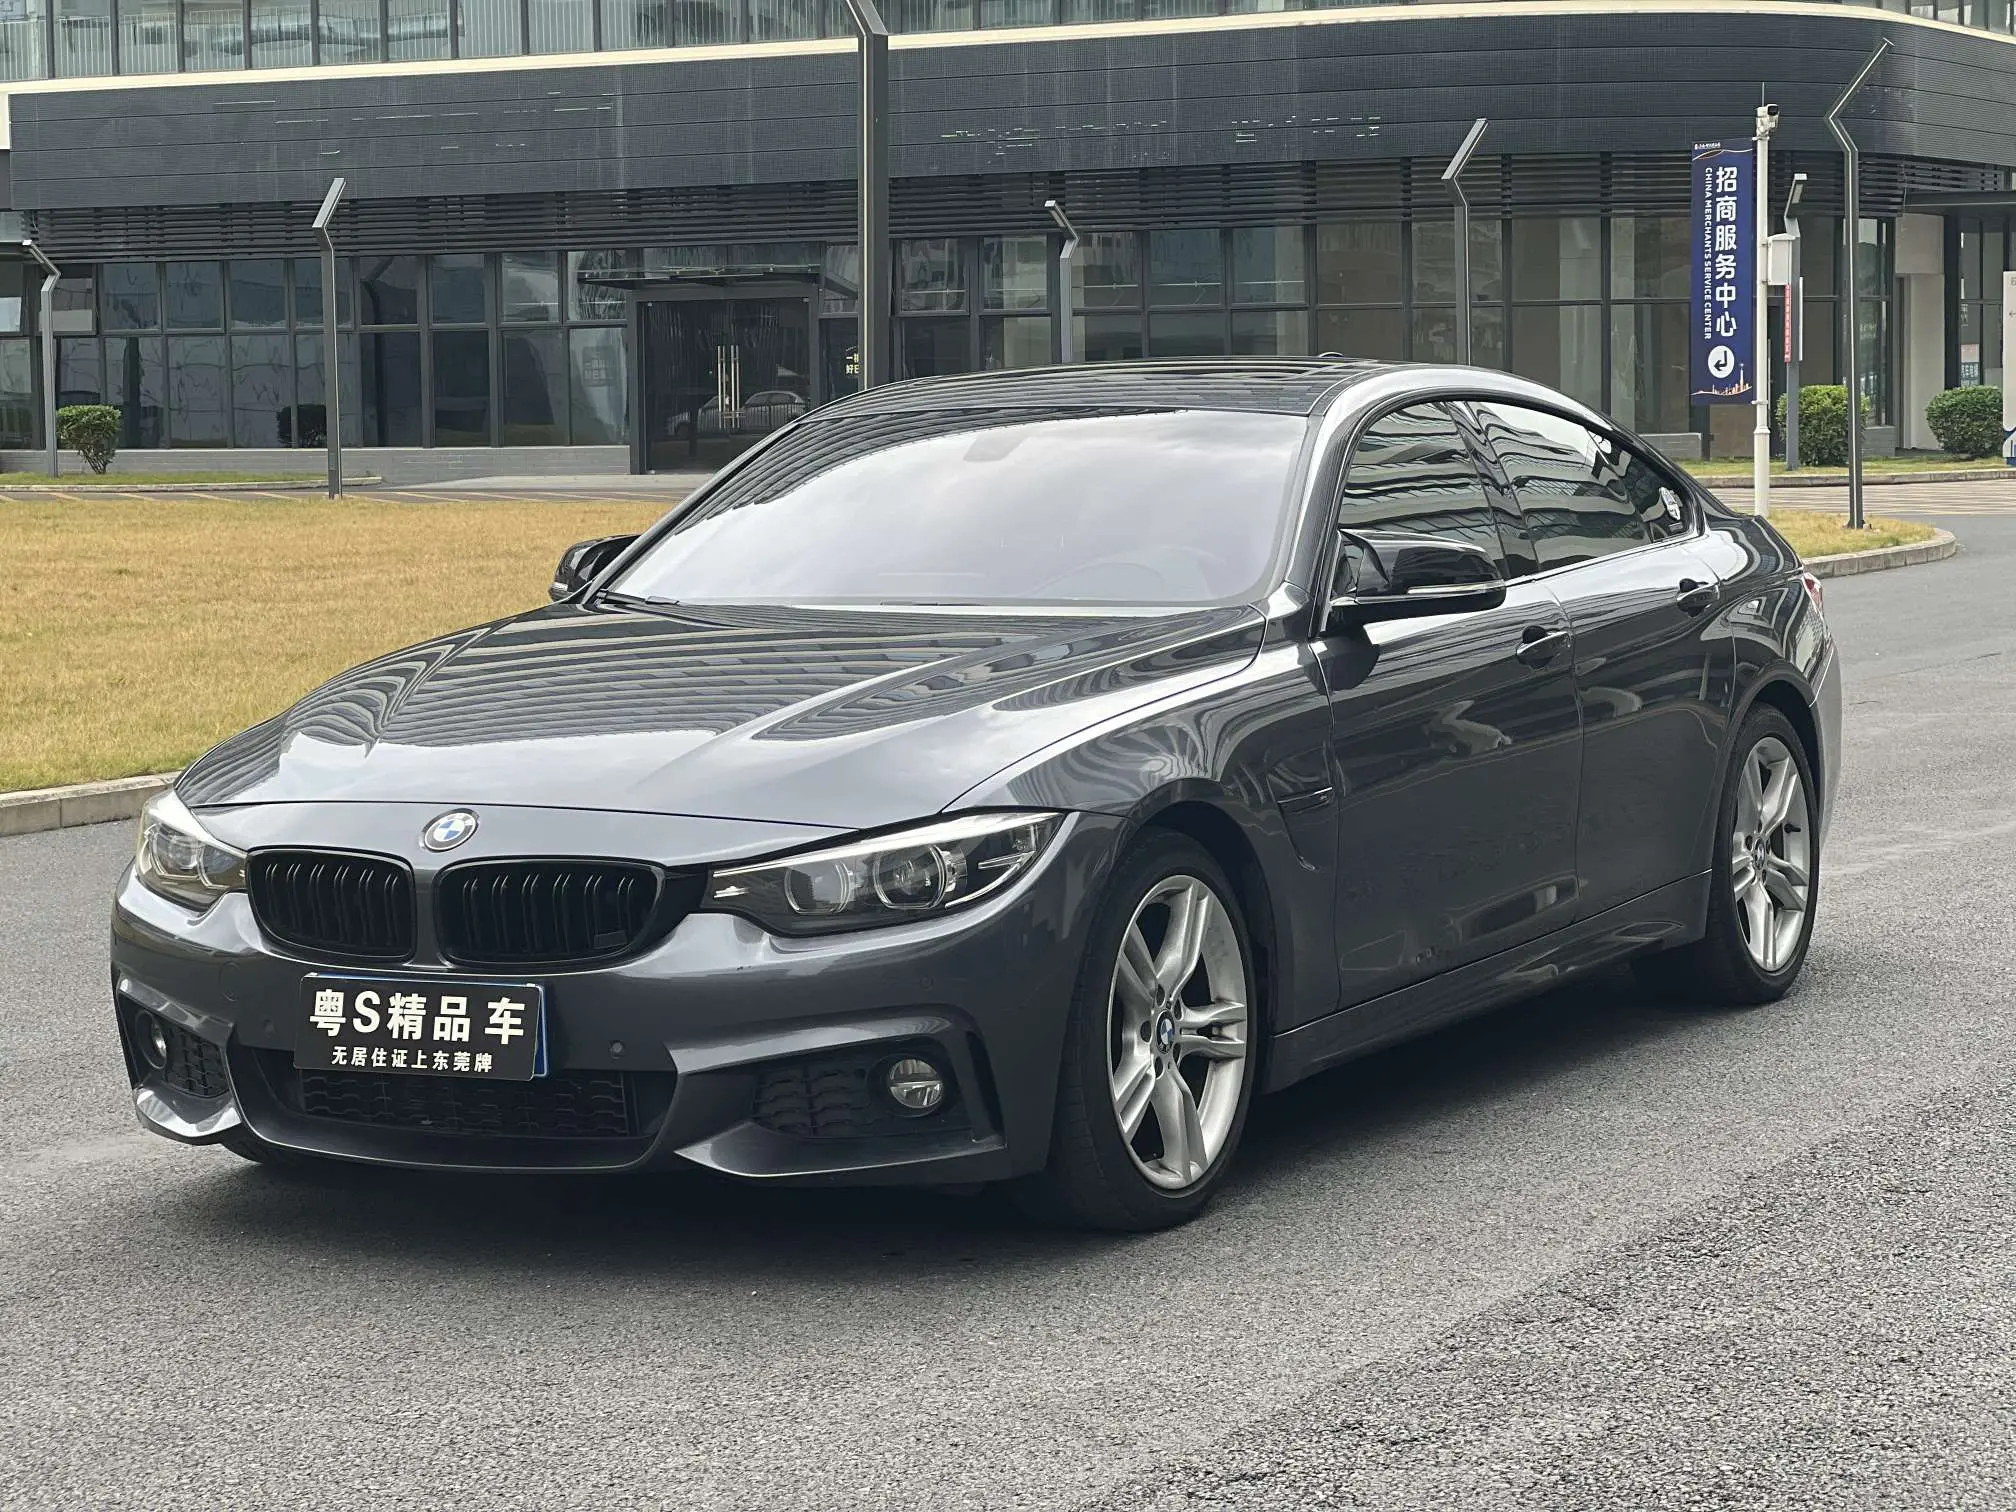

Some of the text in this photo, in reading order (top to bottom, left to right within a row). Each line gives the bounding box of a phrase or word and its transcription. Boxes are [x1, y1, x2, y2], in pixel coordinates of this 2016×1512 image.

[1704, 200, 1712, 259] MERCHANTS
[1715, 166, 1738, 336] 招商服务中心
[1704, 260, 1712, 300] SERVICE
[309, 989, 525, 1045] 粤S精品车
[331, 1046, 493, 1073] 无居住证上东莞牌
